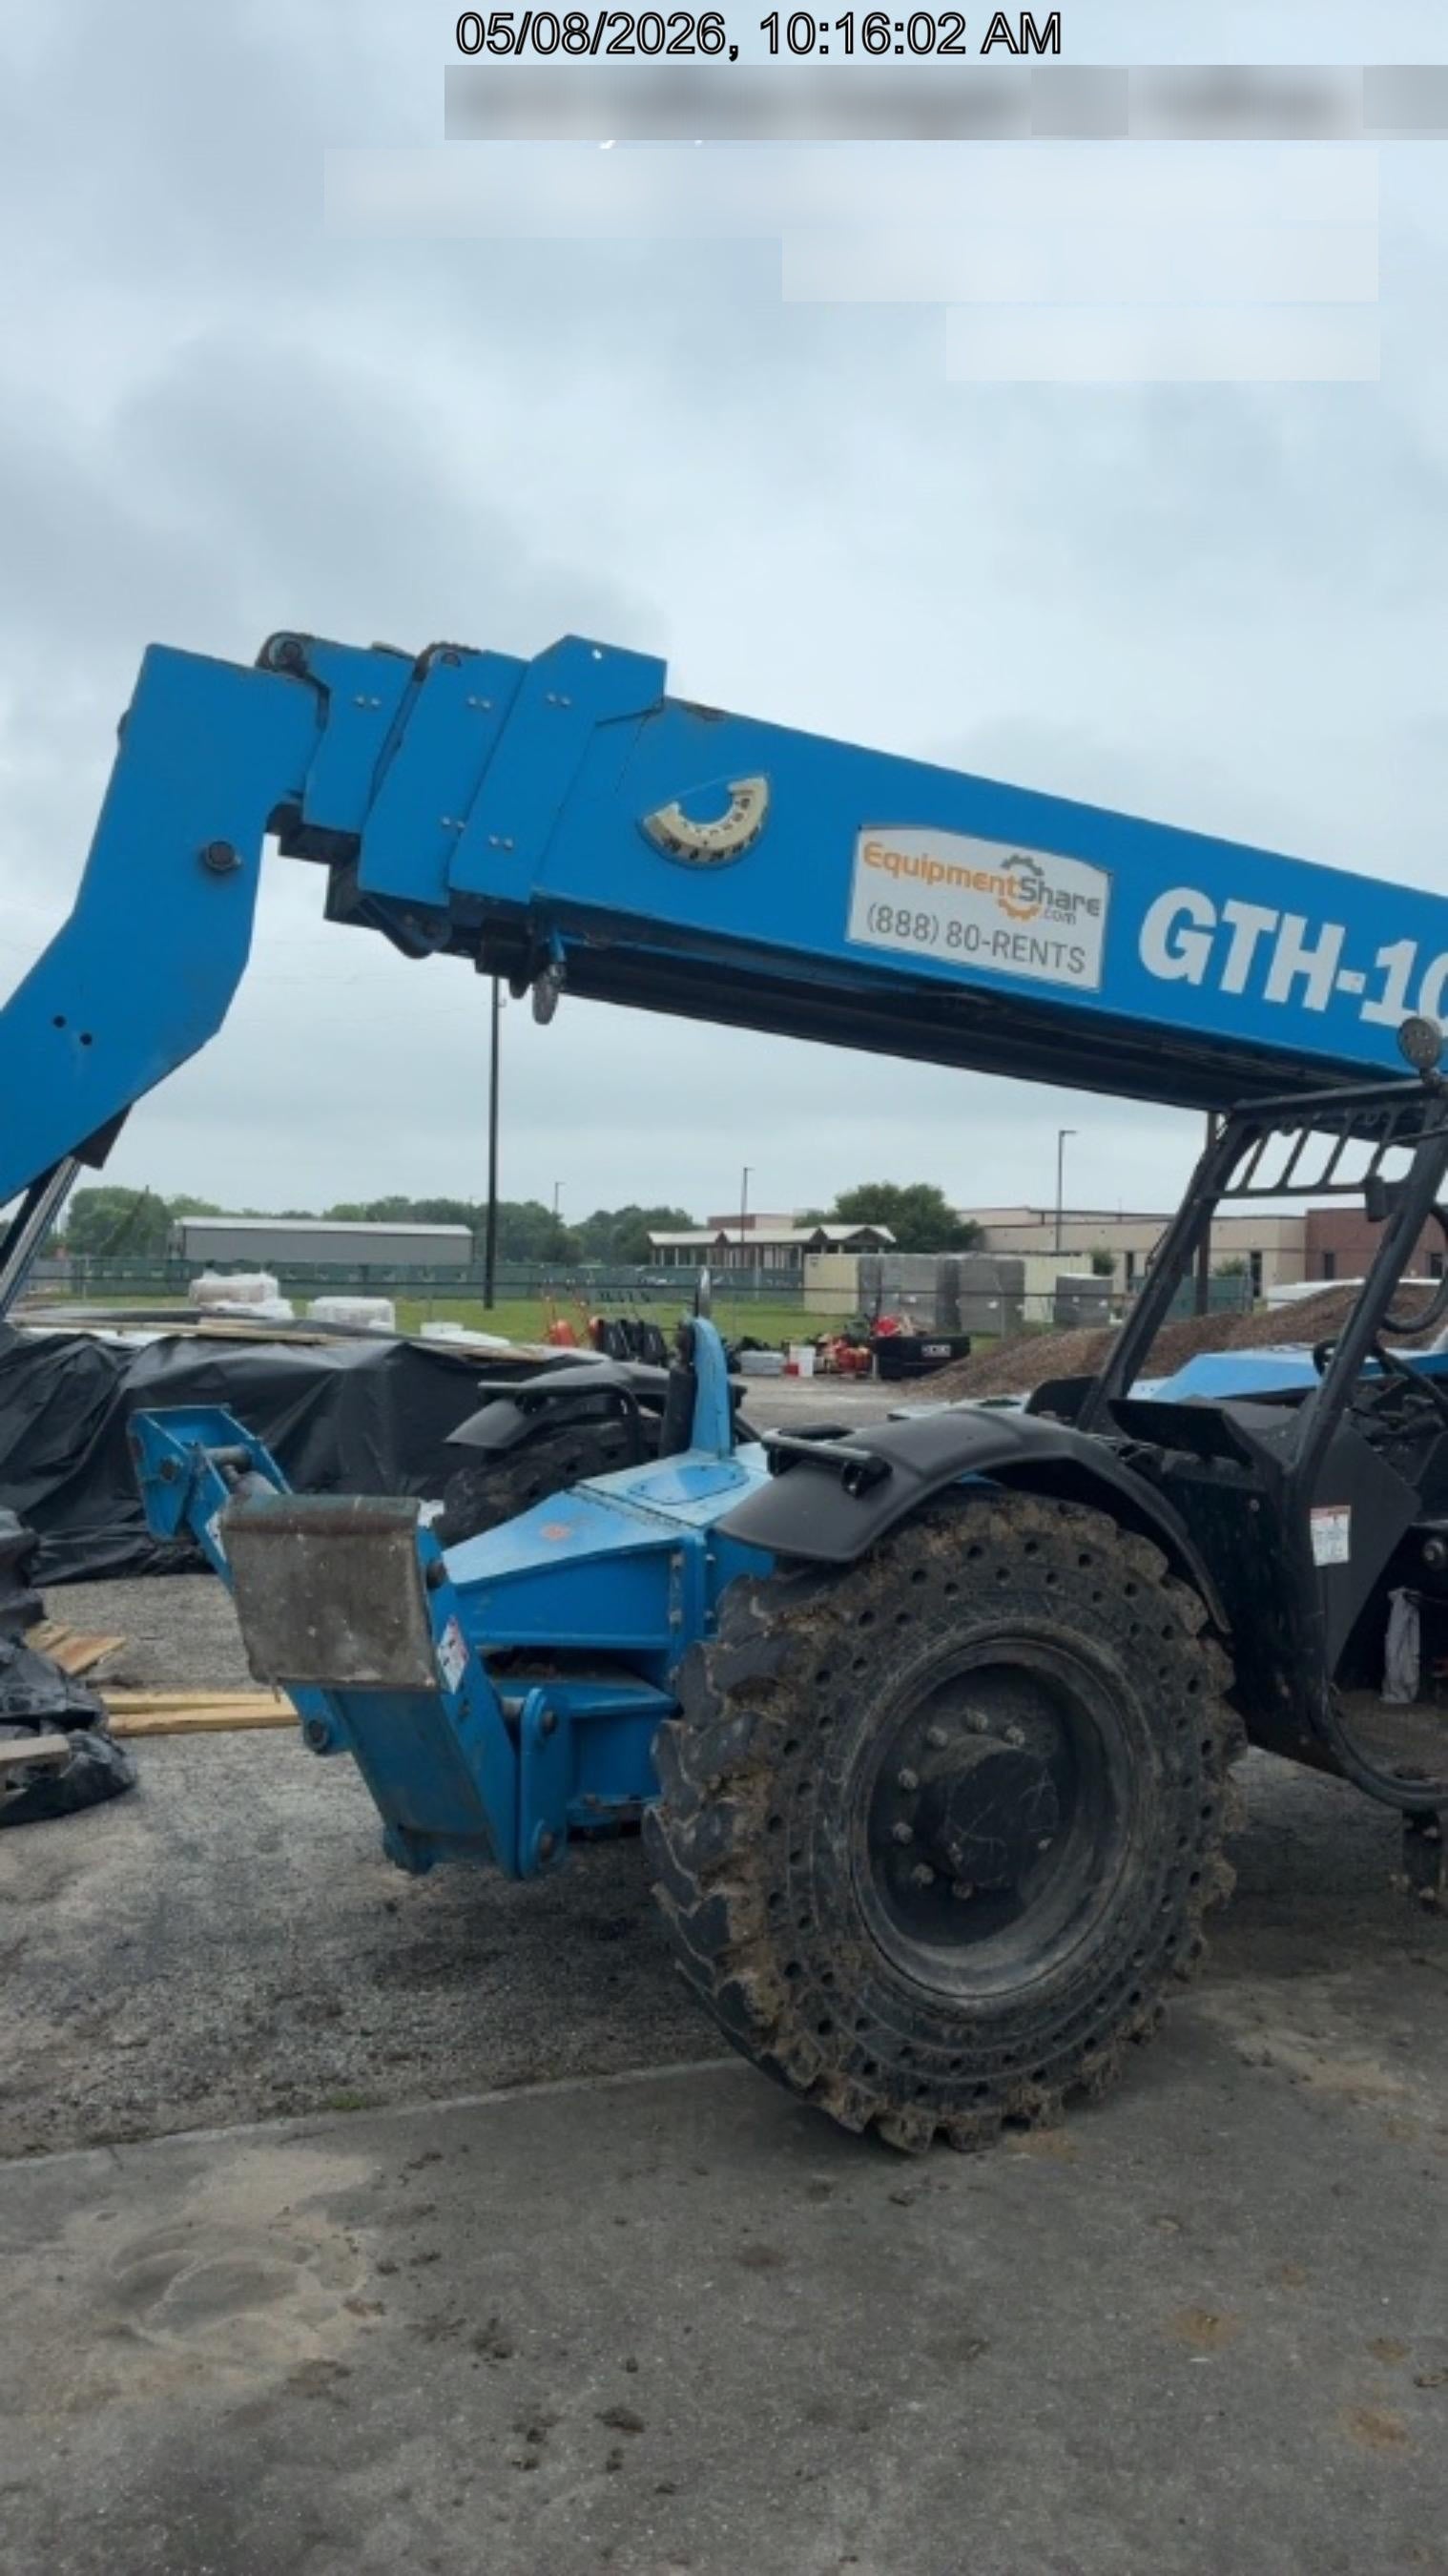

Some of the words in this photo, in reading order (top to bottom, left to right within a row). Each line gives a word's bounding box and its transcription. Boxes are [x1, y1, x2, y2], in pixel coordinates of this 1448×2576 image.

[863, 841, 1101, 917] EquipmentShare
[867, 902, 940, 945] (888)
[945, 919, 1086, 974] 80-RENTS
